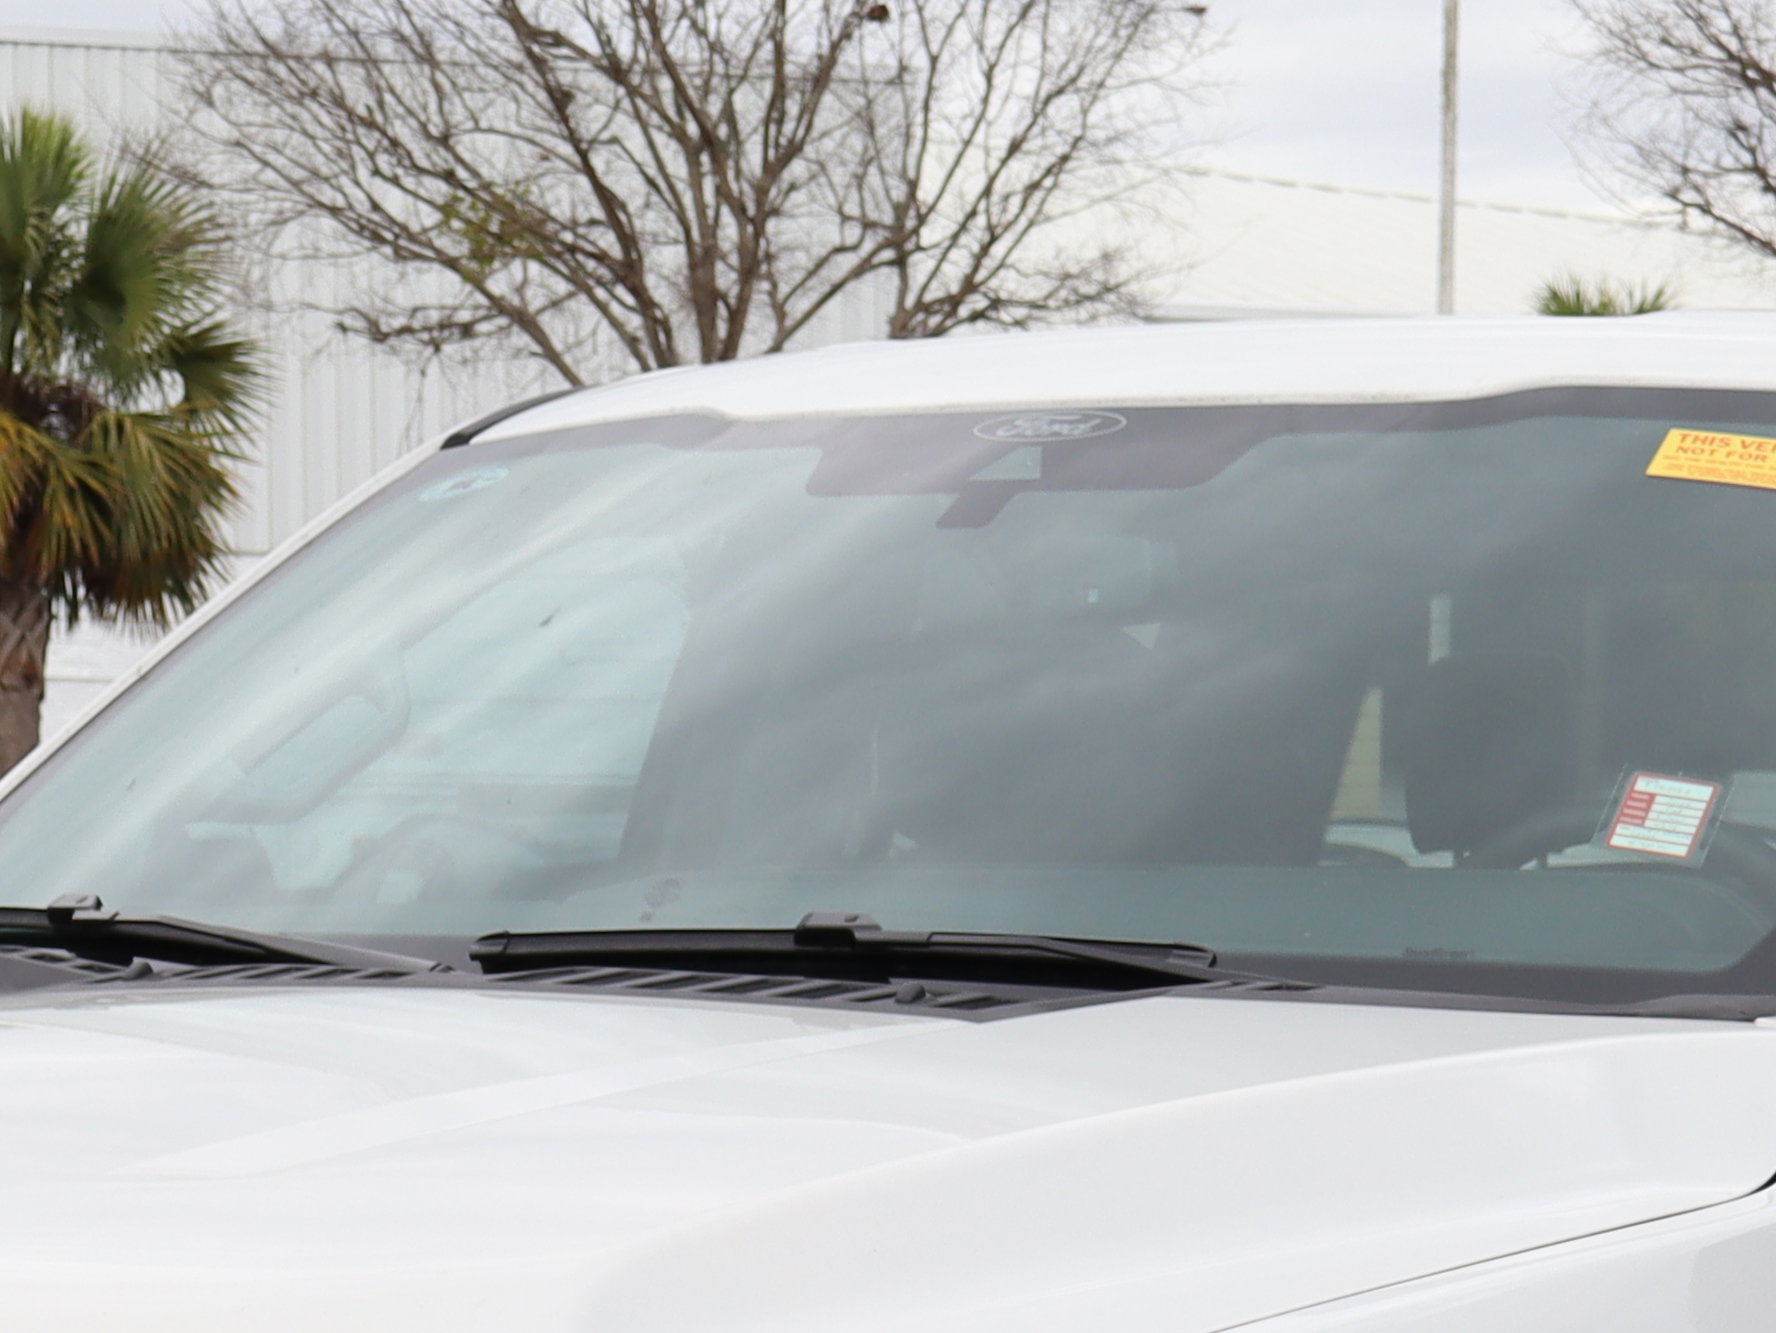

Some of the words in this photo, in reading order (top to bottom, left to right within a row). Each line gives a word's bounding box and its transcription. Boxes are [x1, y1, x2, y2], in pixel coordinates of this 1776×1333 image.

[996, 414, 1102, 437] Ford
[1678, 432, 1733, 448] THIS
[1676, 445, 1720, 457] NOT
[1725, 450, 1769, 462] FOR
